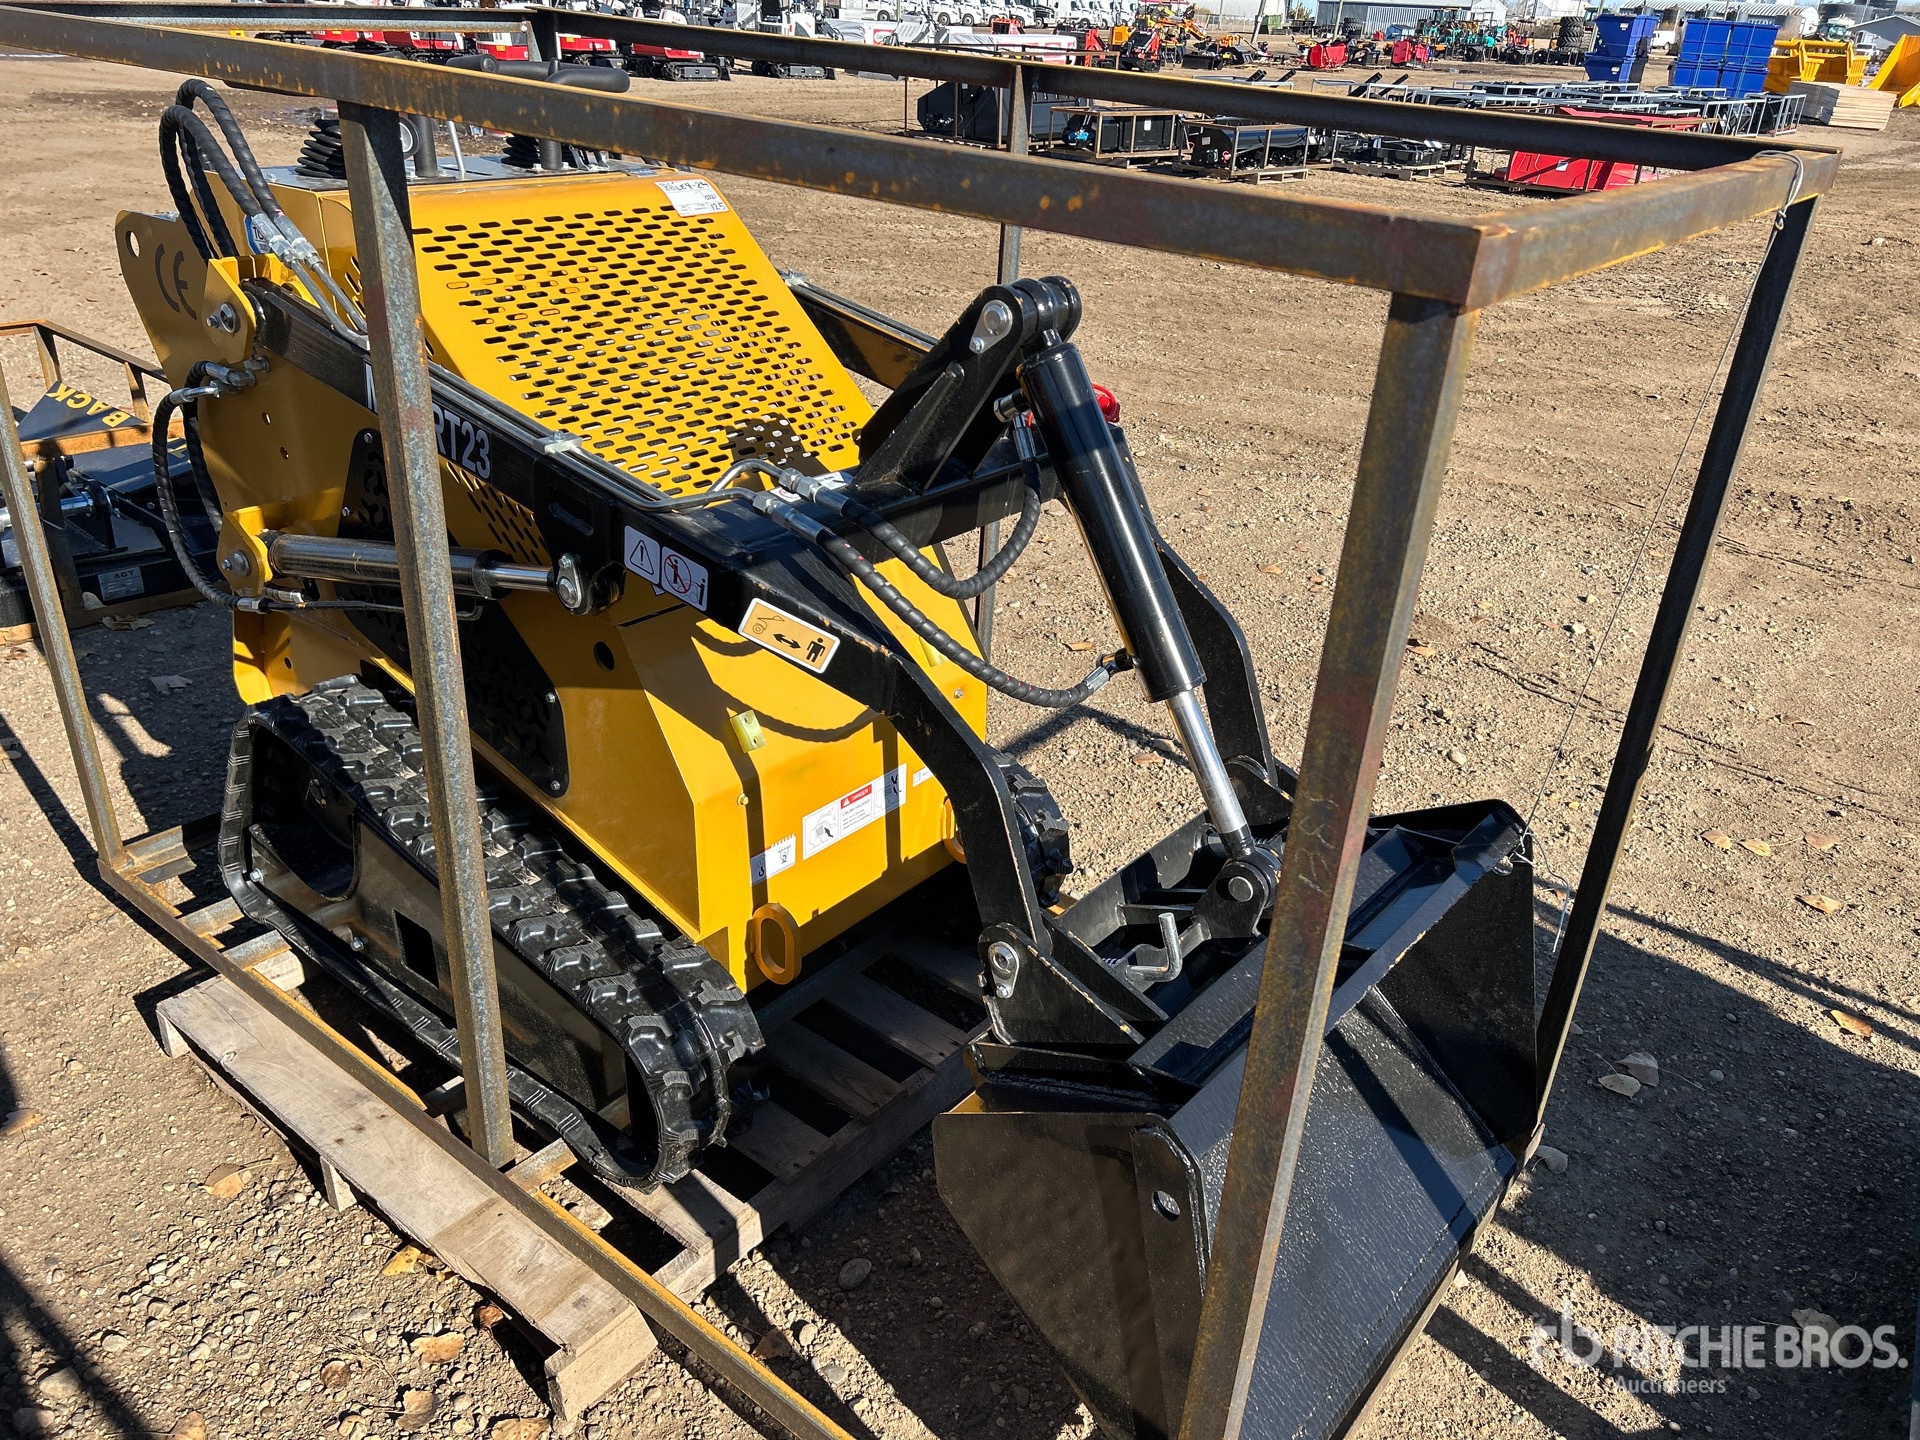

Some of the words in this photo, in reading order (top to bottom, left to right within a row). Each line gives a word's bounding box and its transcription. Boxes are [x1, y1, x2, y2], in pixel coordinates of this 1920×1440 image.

[710, 202, 726, 211] 125
[46, 383, 131, 428] BACK
[114, 569, 135, 579] AGT
[851, 788, 869, 801] DANGER
